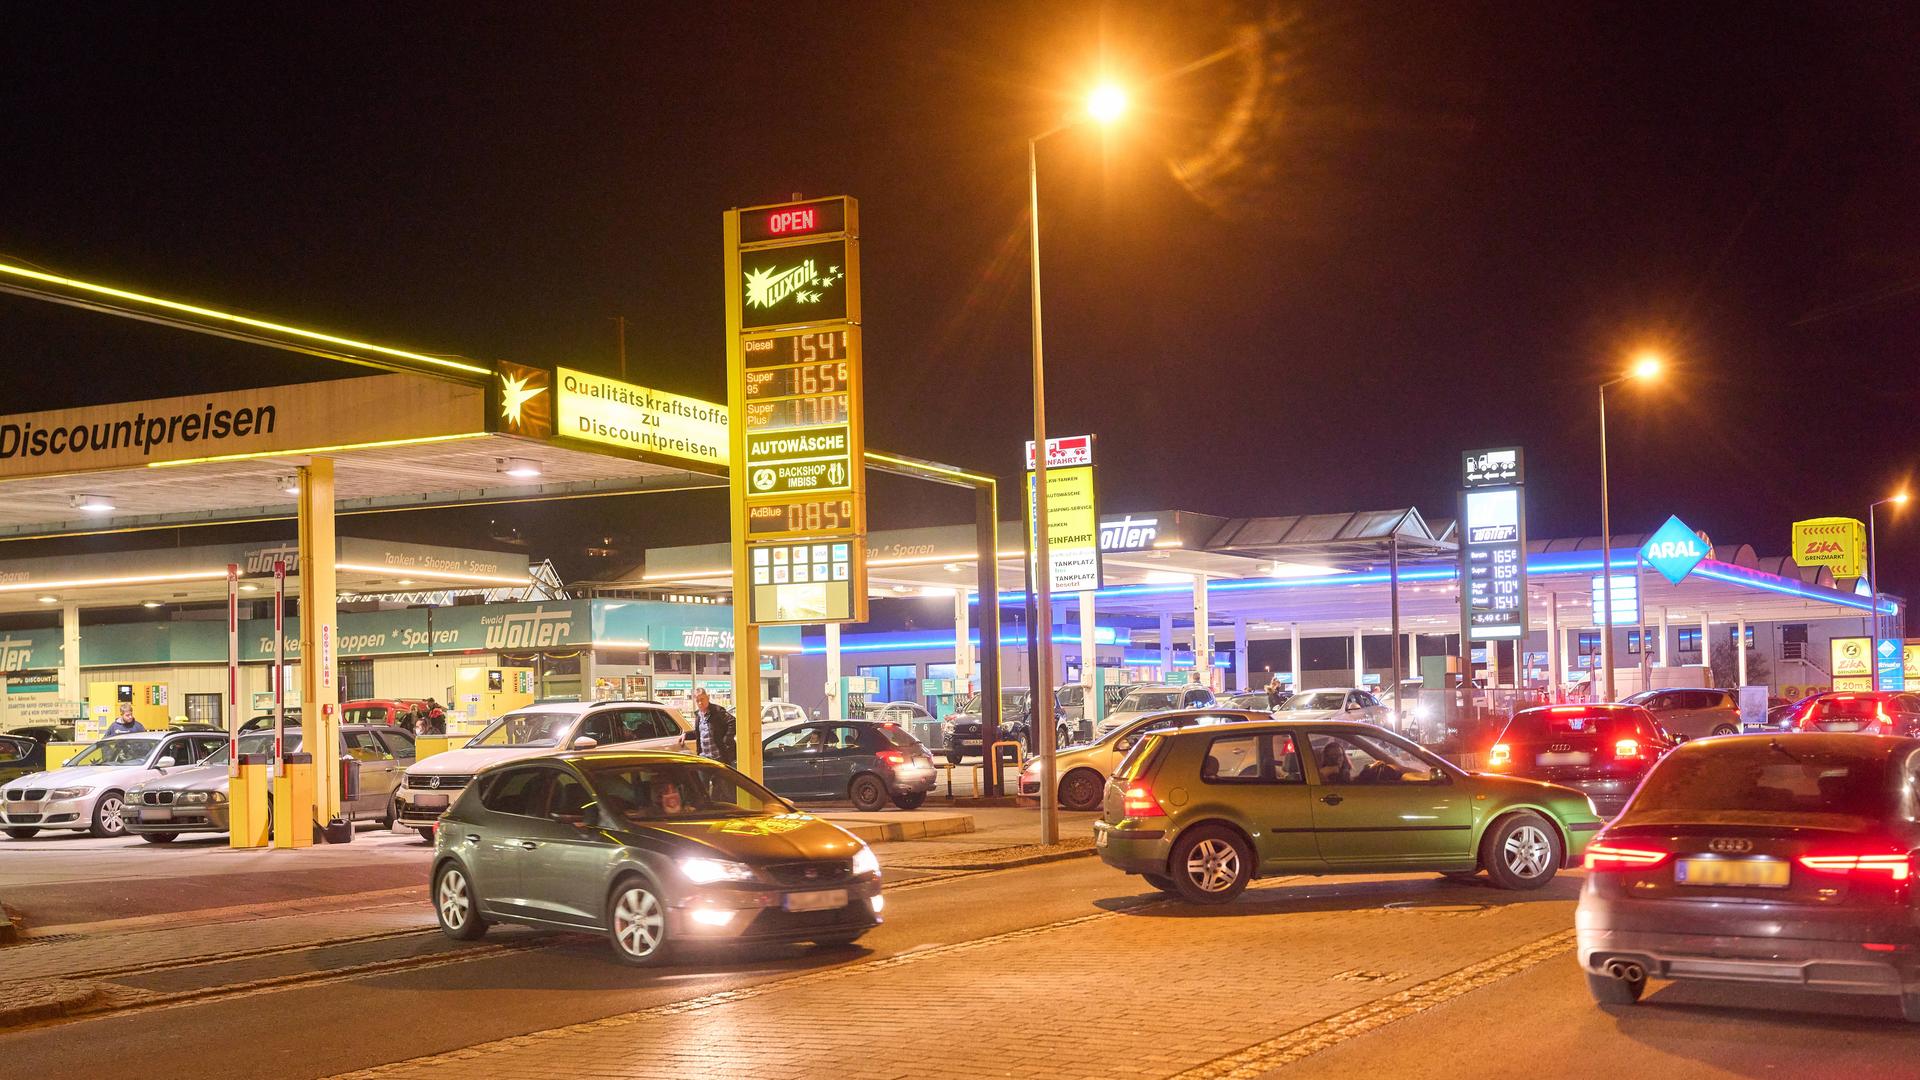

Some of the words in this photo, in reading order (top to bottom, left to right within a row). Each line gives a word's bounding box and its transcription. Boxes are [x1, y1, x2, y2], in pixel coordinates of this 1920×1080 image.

[770, 209, 813, 233] OPEN
[745, 340, 774, 352] Diesel
[746, 373, 774, 384] Super
[747, 385, 759, 394] 95
[564, 376, 728, 426] Qualitätskraftstoffe
[748, 404, 775, 415] Super
[642, 413, 660, 427] zu
[748, 416, 767, 425] Plus
[0, 403, 276, 458] Discountpreisen
[579, 416, 718, 458] Discountpreisen
[751, 435, 845, 456] AUTOWÄSCHE
[1047, 456, 1077, 466] NFAHRT
[779, 465, 826, 478] BACKSHOP
[788, 476, 817, 488] IMBISS
[750, 507, 782, 518] AdBlue
[1100, 515, 1158, 550] olter
[1048, 534, 1093, 545] EINFAHRT
[893, 543, 935, 558] Sparen
[1648, 540, 1700, 560] ARAL
[384, 552, 415, 566] Tanken
[424, 556, 461, 571] Shoppen
[469, 560, 497, 573] Sparen
[1055, 559, 1094, 567] TANKPLATZ
[1056, 573, 1095, 582] TANKPLATZ
[480, 615, 504, 625] Ewald
[485, 605, 572, 649] Wolter
[260, 635, 301, 653] Take
[337, 634, 386, 653] oppen
[402, 628, 459, 649] Sparen
[684, 626, 719, 648] Wolter
[1842, 681, 1864, 690] 20m
